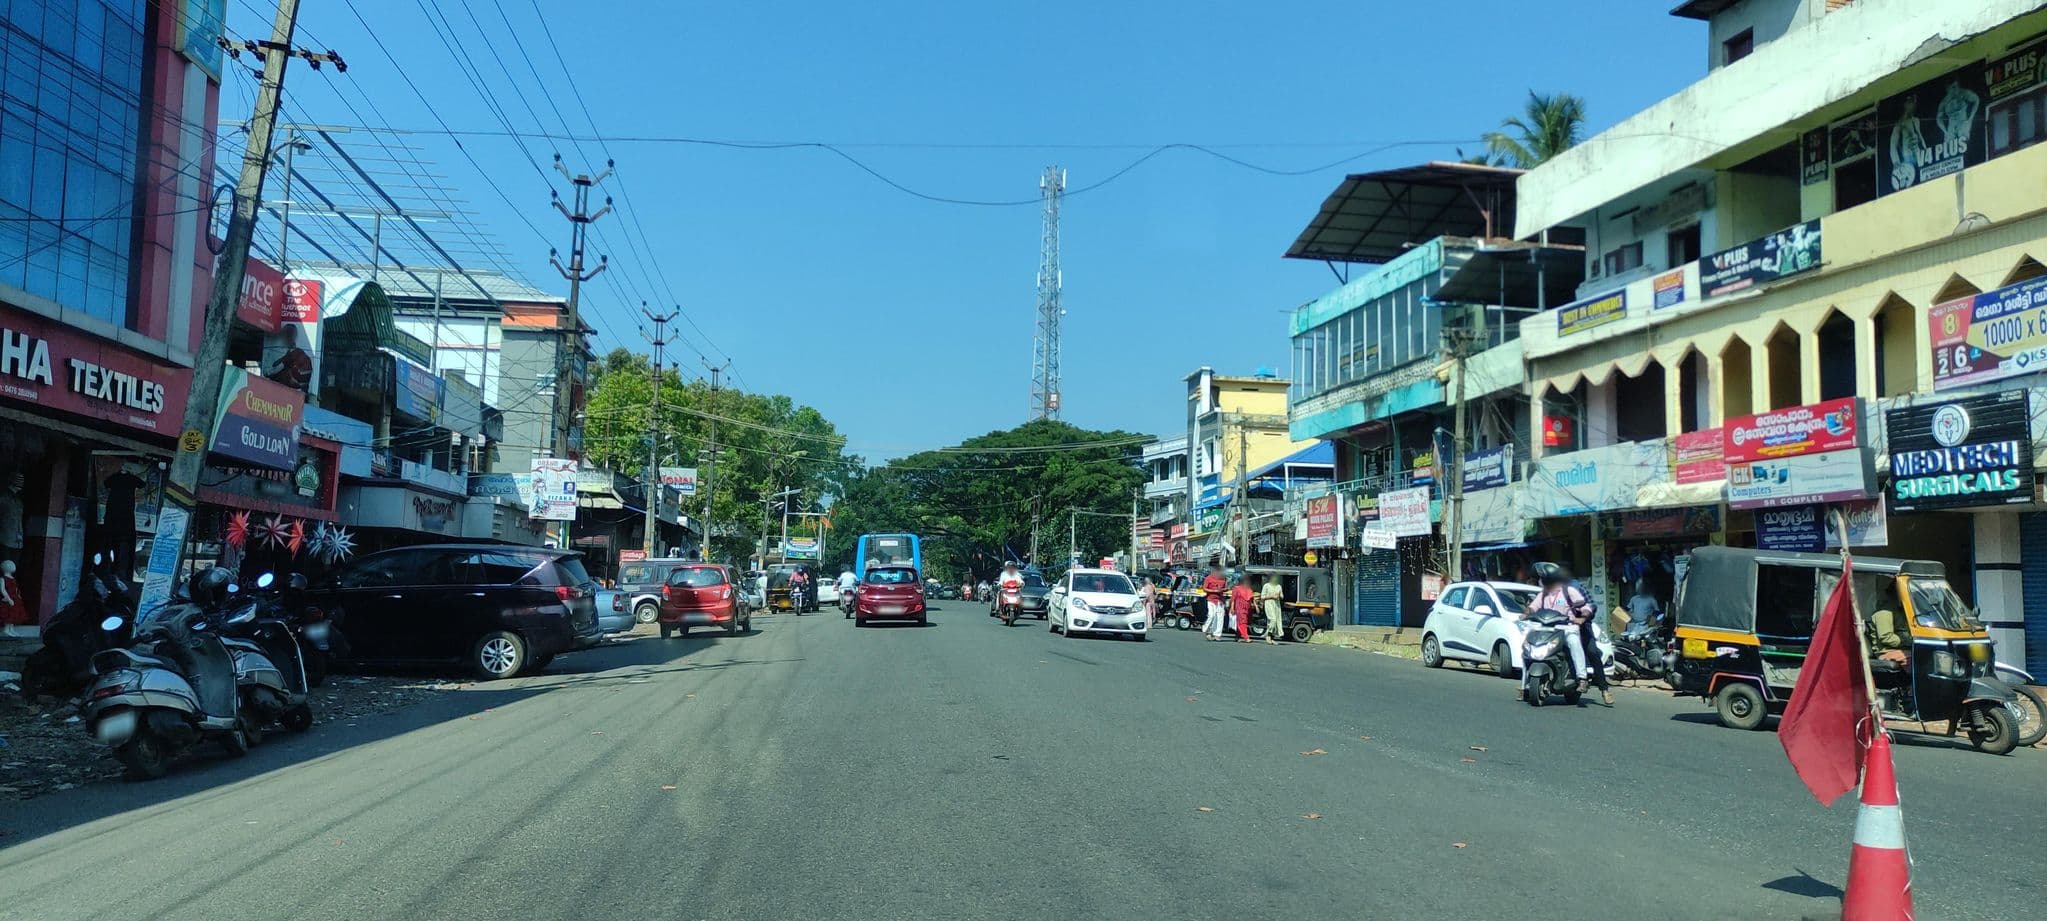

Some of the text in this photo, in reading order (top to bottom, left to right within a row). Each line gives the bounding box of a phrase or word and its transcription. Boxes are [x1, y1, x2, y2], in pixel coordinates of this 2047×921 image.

[2004, 51, 2037, 79] PLUS
[1916, 136, 1967, 167] V4 PLUS
[1805, 160, 1827, 177] PLUS
[1724, 247, 1749, 267] PLUS
[281, 311, 306, 319] Group
[1944, 313, 1956, 336] 8
[1983, 316, 2022, 348] 10000
[1938, 358, 1949, 376] 2
[1954, 345, 1968, 368] 6
[1, 328, 164, 414] HA TEXTILES
[241, 425, 290, 457] GOLD LOAN
[1892, 441, 2018, 476] MEDITECH
[1731, 486, 1772, 498] Computers
[1895, 469, 2021, 499] SURGICALS
[1780, 495, 1824, 505] COMPLEX
